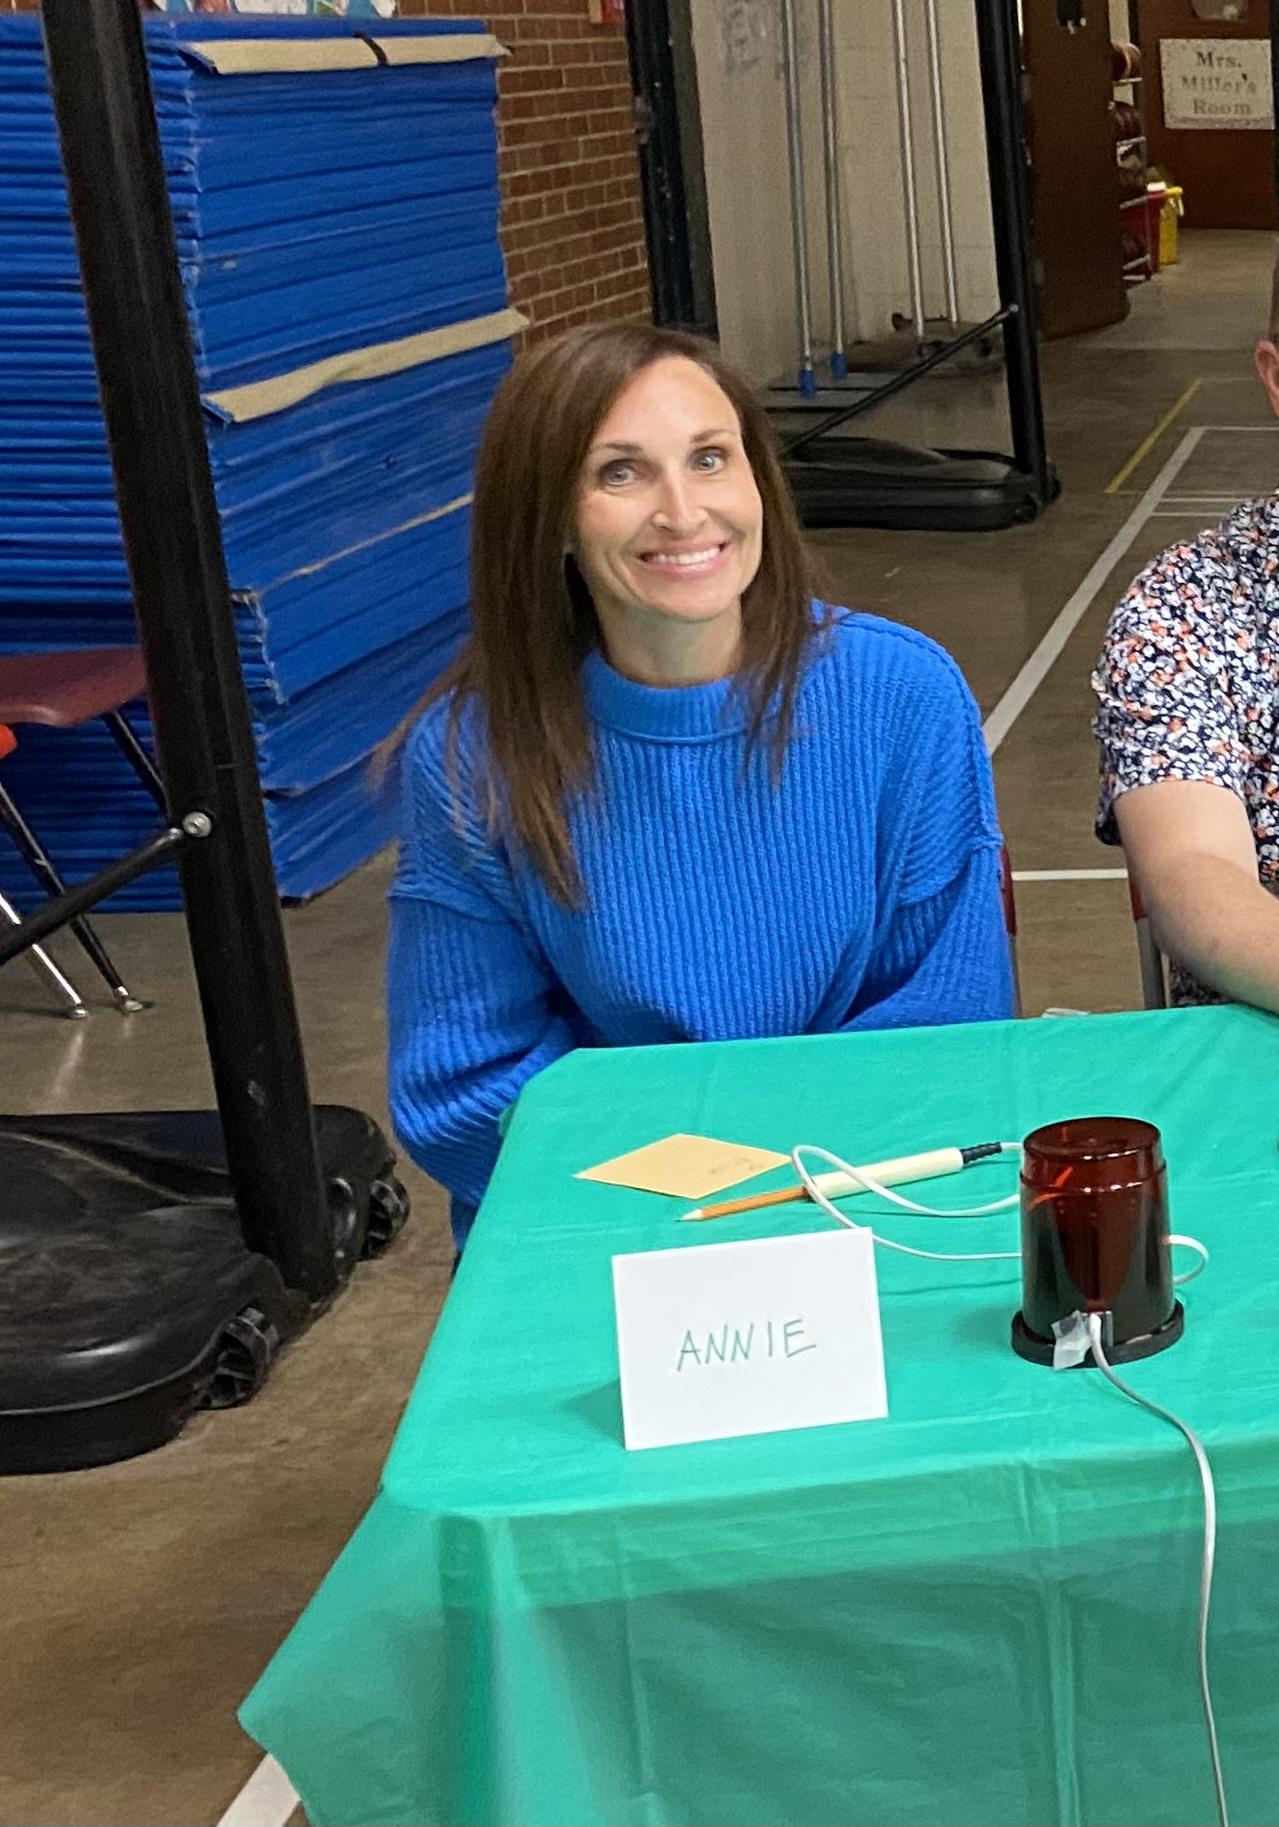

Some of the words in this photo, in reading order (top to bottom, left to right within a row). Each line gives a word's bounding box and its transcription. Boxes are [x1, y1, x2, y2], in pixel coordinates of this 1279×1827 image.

[1196, 51, 1242, 68] Mrs.
[1181, 73, 1257, 94] Miller's
[1193, 99, 1251, 115] Room
[676, 1318, 817, 1372] ANNIE
